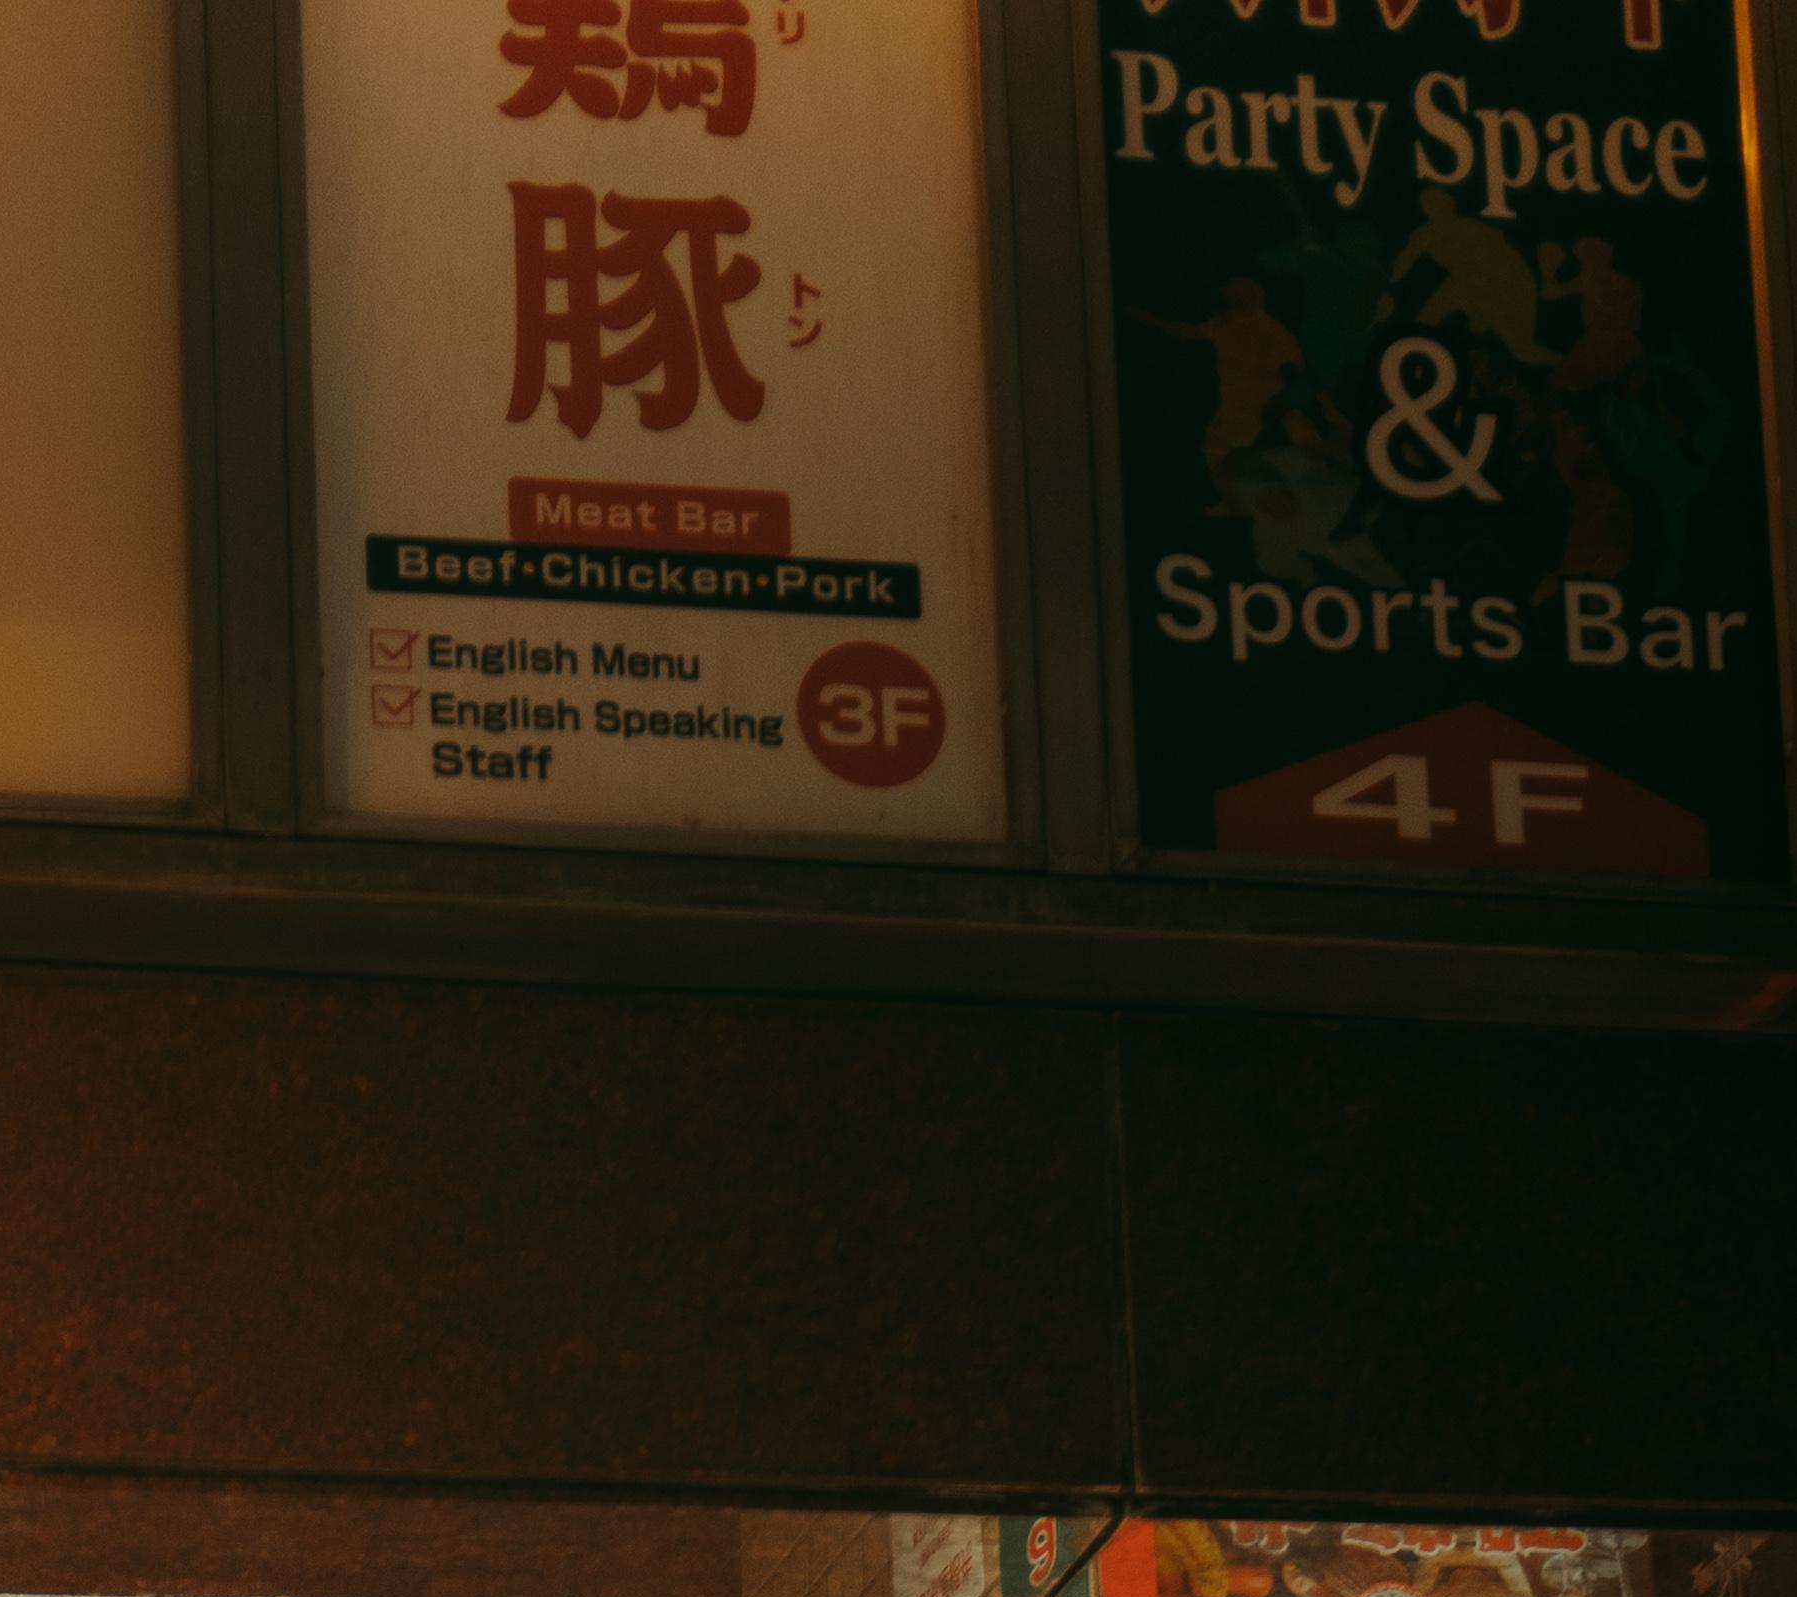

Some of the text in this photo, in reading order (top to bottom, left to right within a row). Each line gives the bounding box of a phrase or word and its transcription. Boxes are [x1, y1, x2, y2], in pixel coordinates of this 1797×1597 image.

[1110, 50, 1707, 219] Party Space
[1366, 336, 1503, 502] &
[535, 493, 760, 536] Meat Bar
[1154, 553, 1748, 672] Sports Bar
[427, 635, 701, 681] English Menu
[429, 693, 784, 749] English Speaking
[818, 682, 931, 749] 3F
[432, 743, 552, 782] Staff
